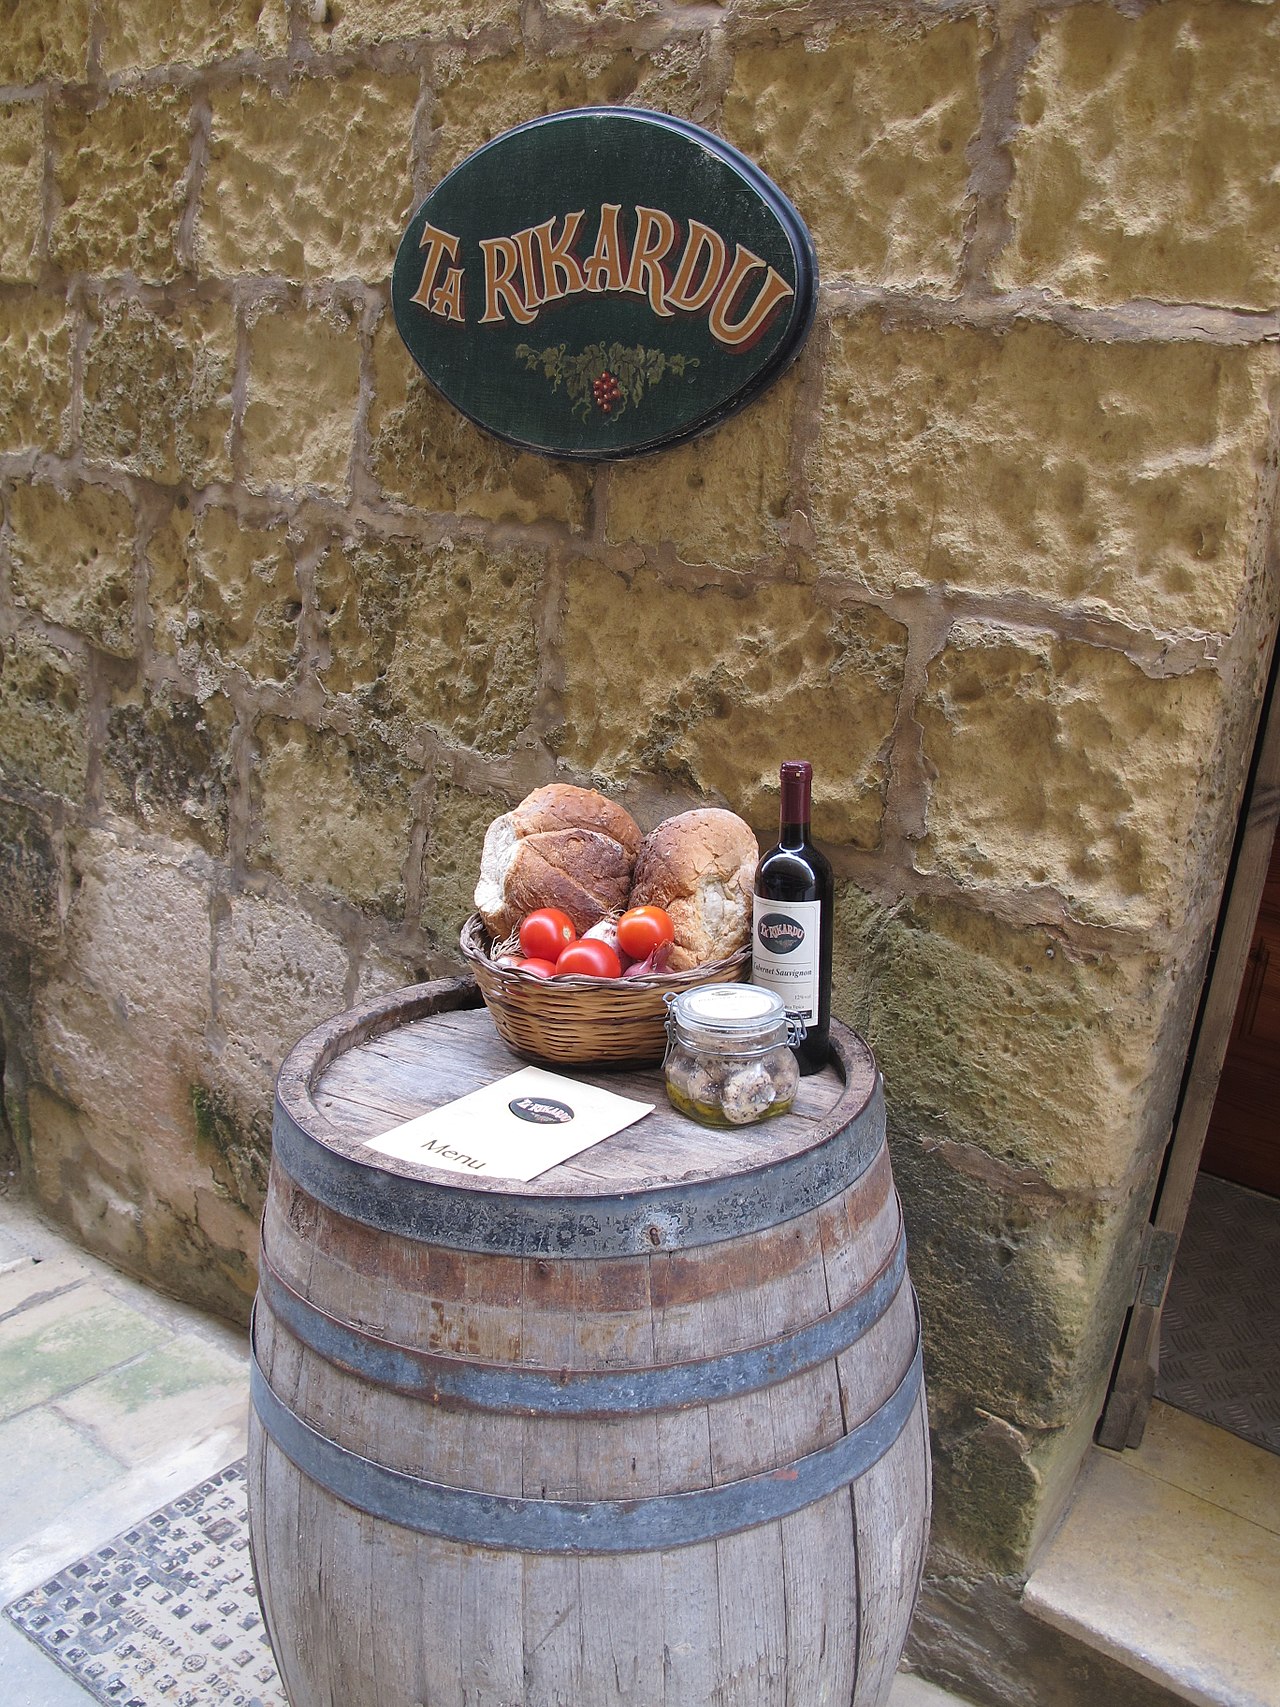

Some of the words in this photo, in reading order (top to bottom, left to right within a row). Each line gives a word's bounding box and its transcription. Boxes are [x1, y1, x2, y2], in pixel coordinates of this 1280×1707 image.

[477, 202, 795, 348] RIKARDU
[768, 923, 804, 939] RIKARDU
[753, 961, 775, 975] Cabernet
[775, 968, 812, 978] Sauvignon
[420, 1139, 487, 1170] Menu
